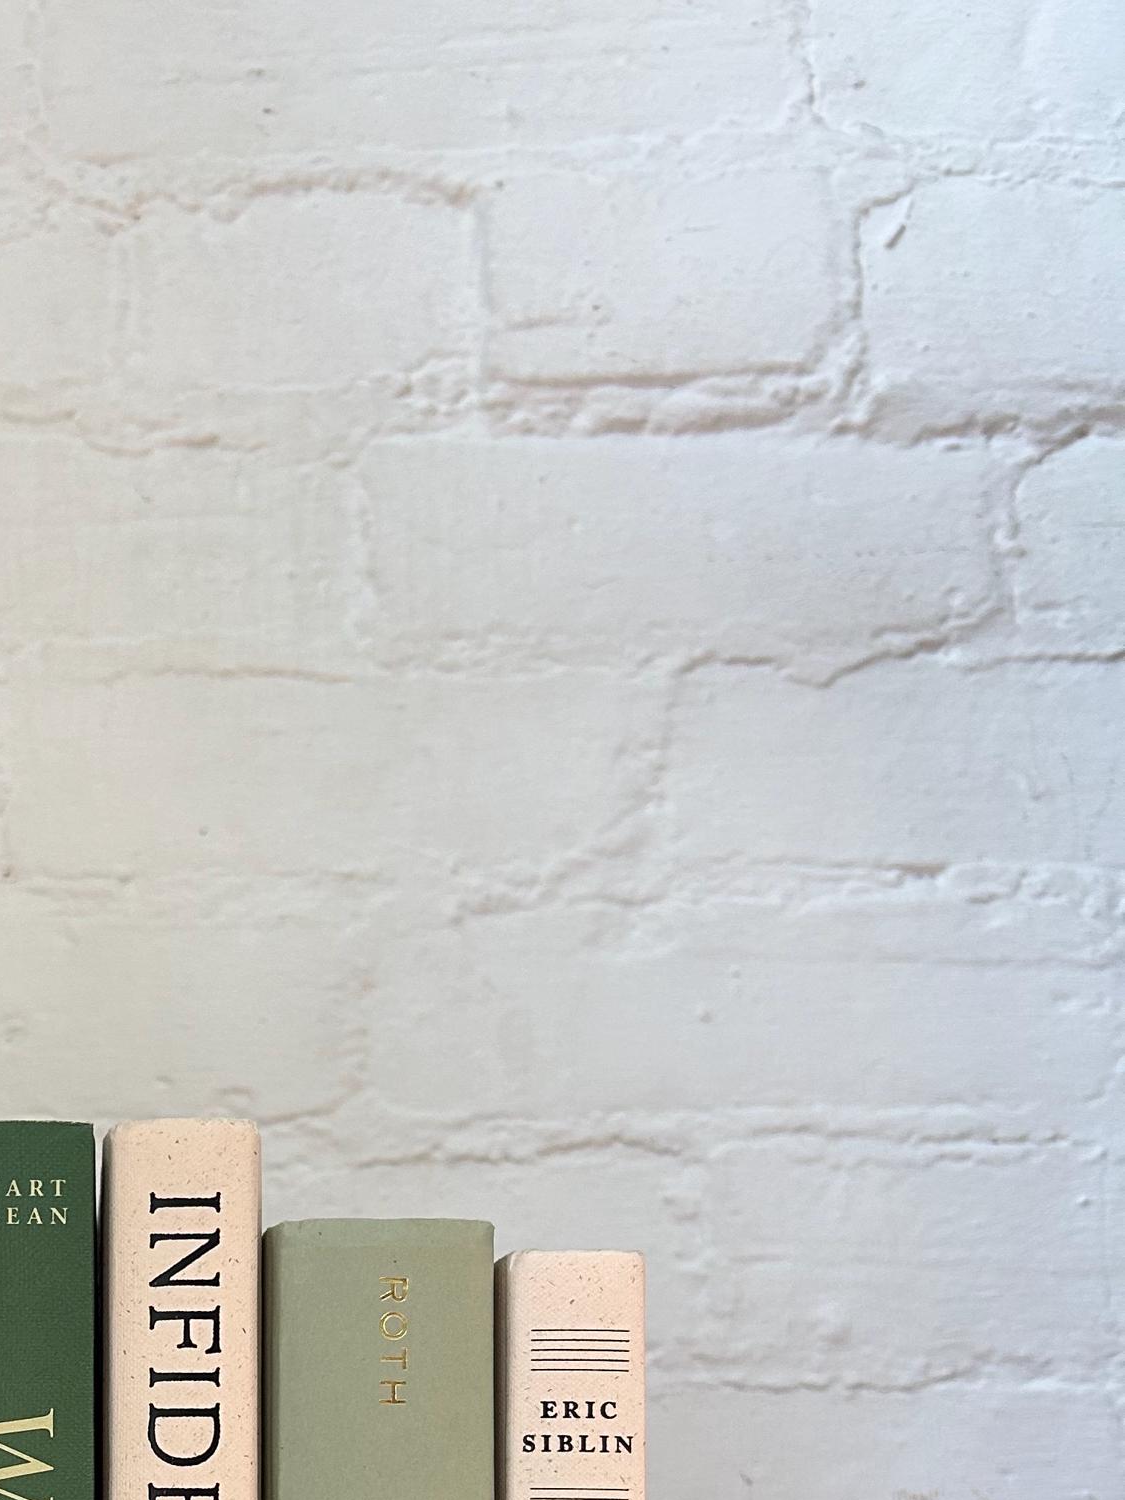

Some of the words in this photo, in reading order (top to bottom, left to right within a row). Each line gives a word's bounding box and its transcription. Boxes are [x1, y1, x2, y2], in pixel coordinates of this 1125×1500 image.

[378, 1275, 410, 1407] ROTH
[540, 1400, 618, 1419] ERIC
[522, 1434, 634, 1454] SIBLIN
